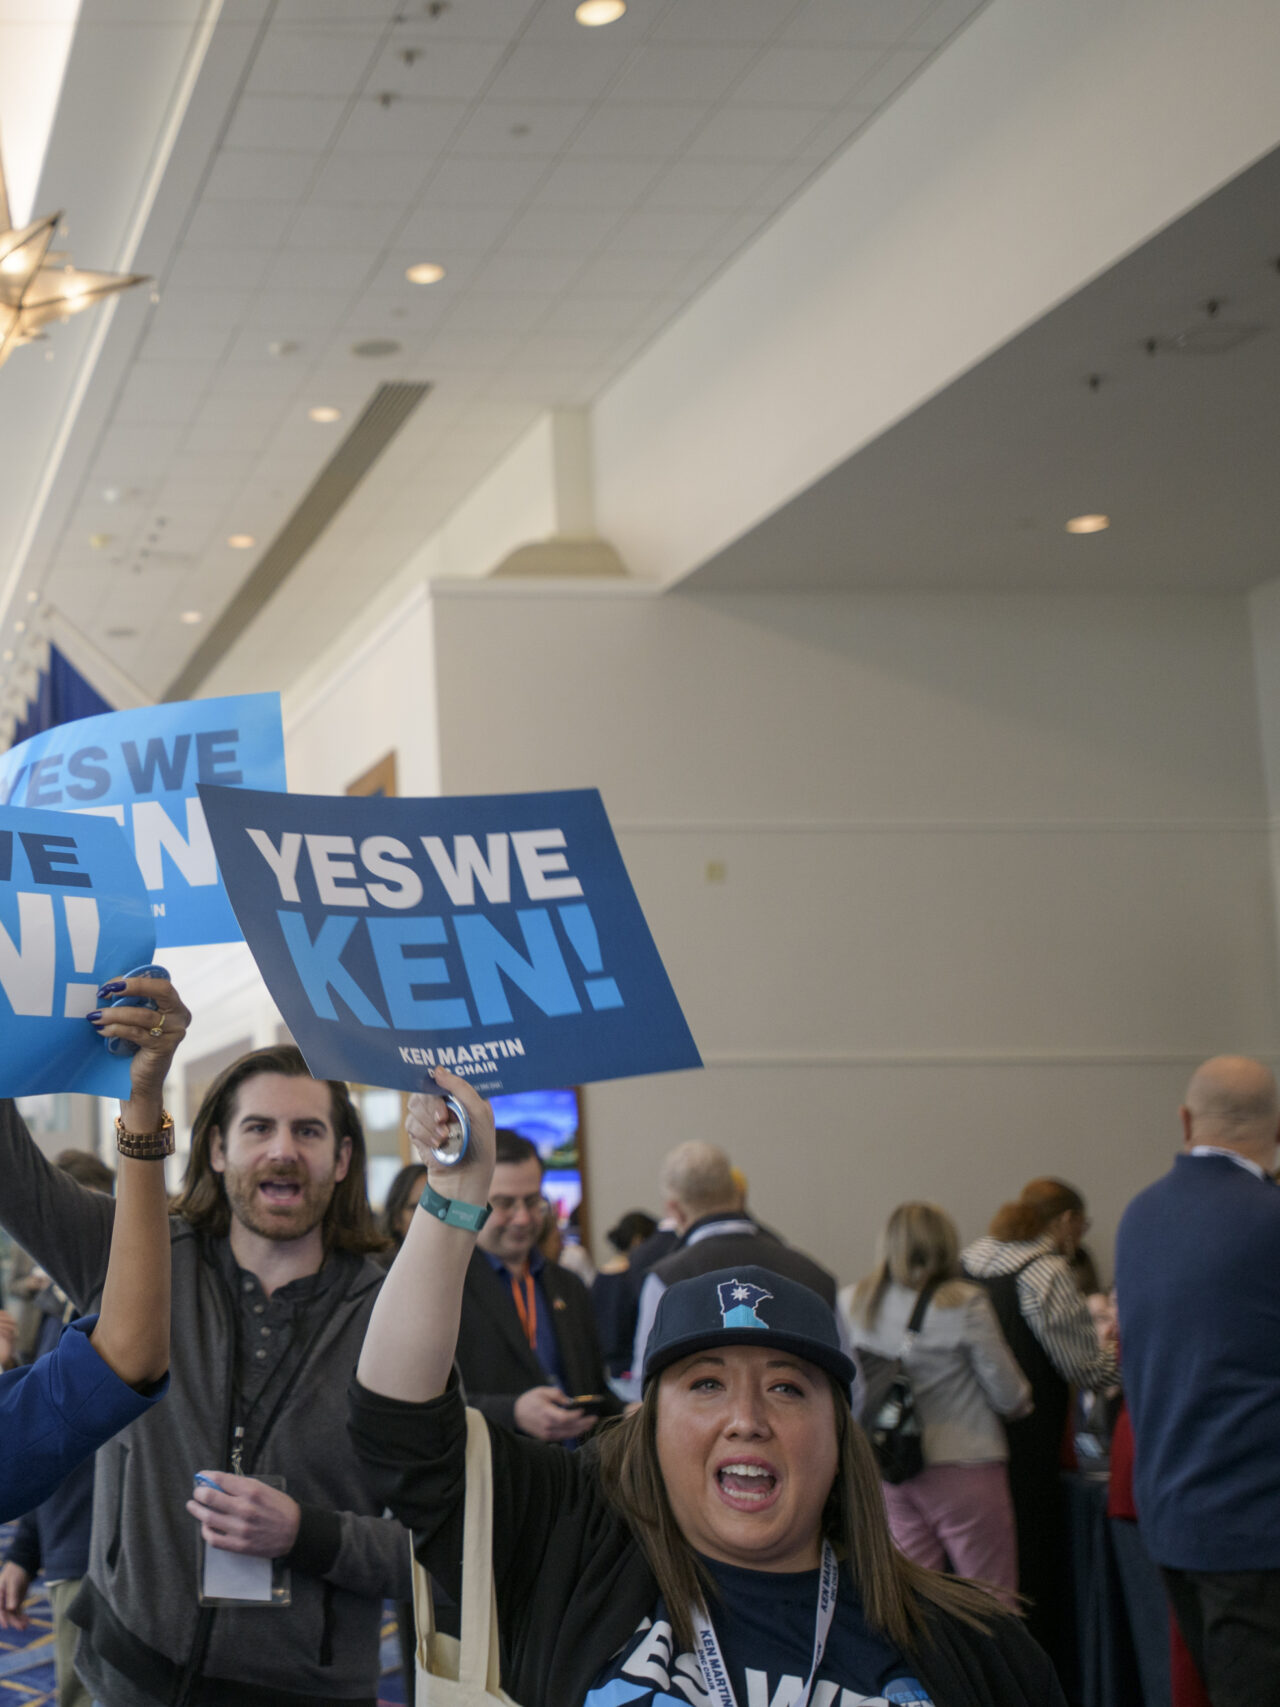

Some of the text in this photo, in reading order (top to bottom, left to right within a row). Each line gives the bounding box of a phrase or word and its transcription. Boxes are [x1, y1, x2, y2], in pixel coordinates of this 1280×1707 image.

[120, 729, 243, 795] WE
[245, 828, 423, 909] YES
[420, 828, 584, 906] WE
[276, 903, 625, 1031] KEN!
[398, 1037, 526, 1066] KEN MARTIN
[455, 1061, 499, 1077] CHAIR
[820, 1543, 832, 1612] KEN MARTIN
[700, 1630, 734, 1707] KEN MARTIN
